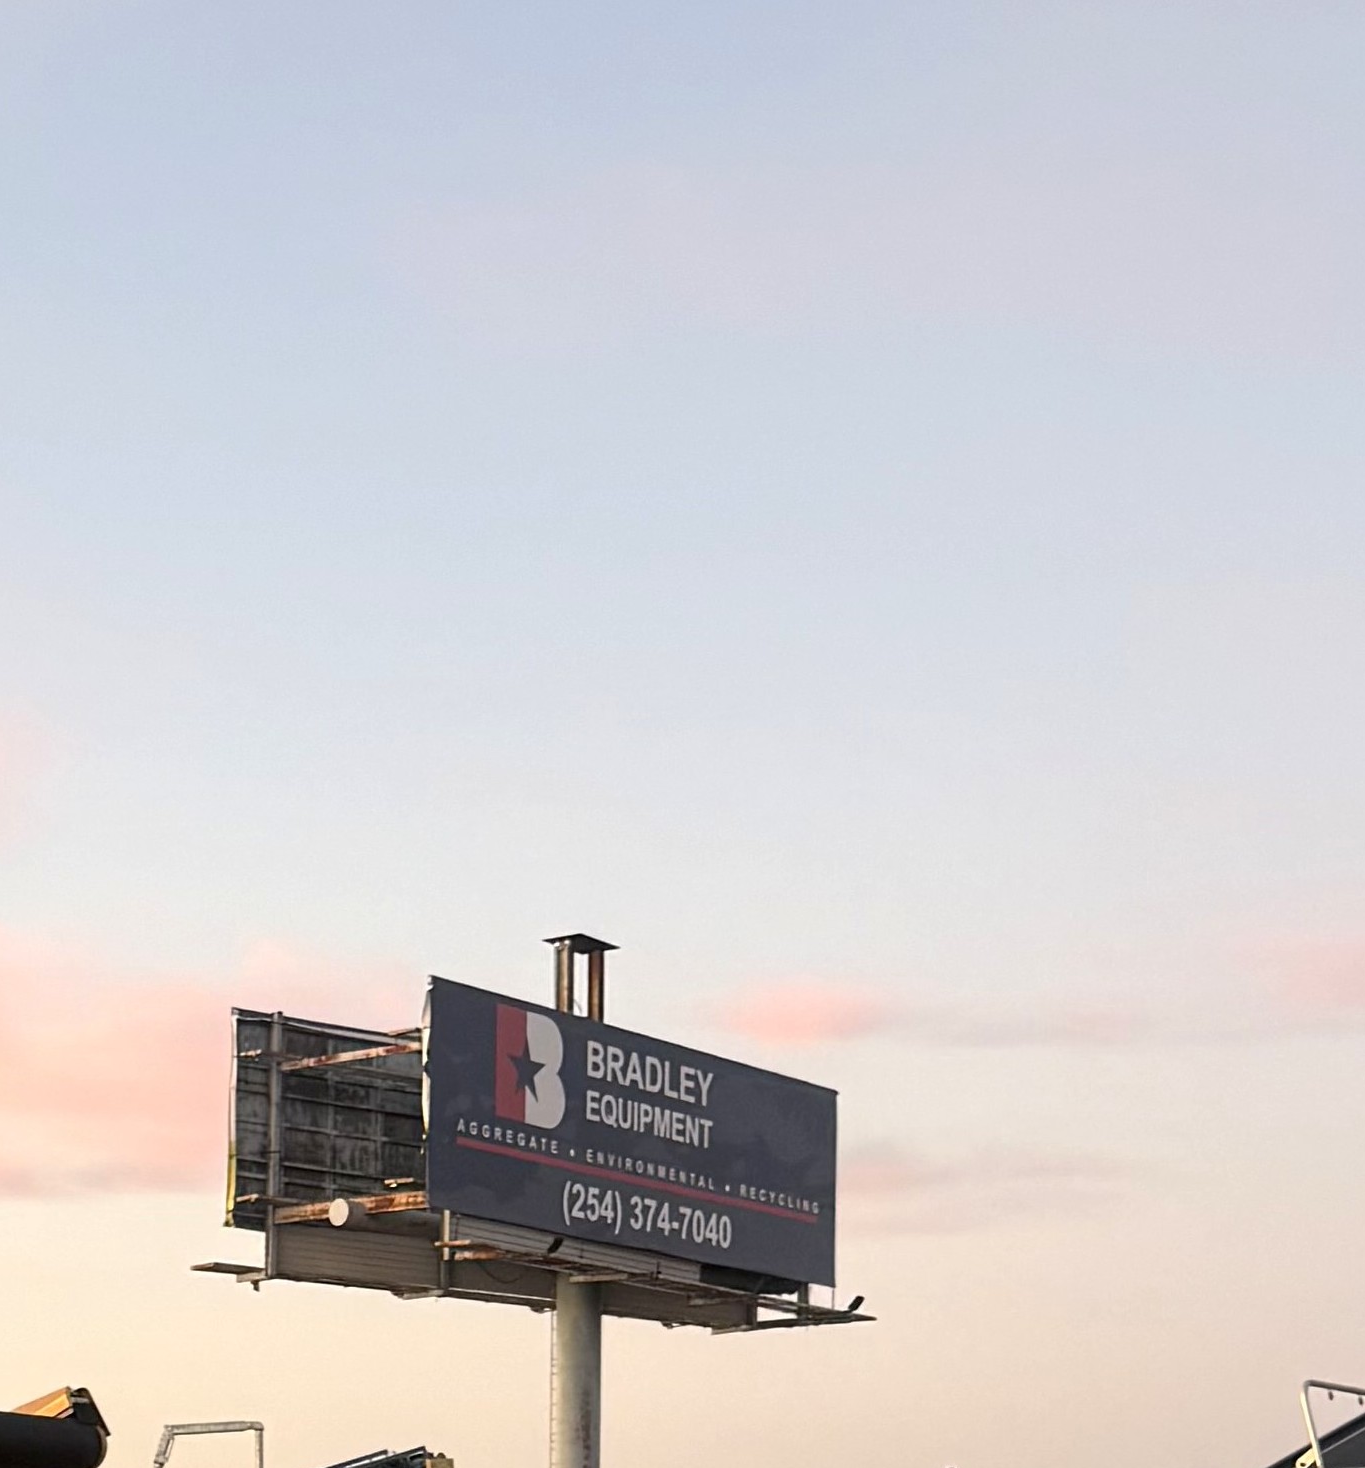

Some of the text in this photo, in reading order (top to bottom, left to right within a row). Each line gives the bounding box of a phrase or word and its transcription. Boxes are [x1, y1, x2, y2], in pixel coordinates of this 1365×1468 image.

[586, 1039, 714, 1107] BRADLEY
[585, 1089, 714, 1149] EQUIPMENT
[456, 1117, 820, 1215] AGGREGATE ENVIRONMENTAL RECYCLING
[562, 1180, 732, 1249] (254) 374-7040
